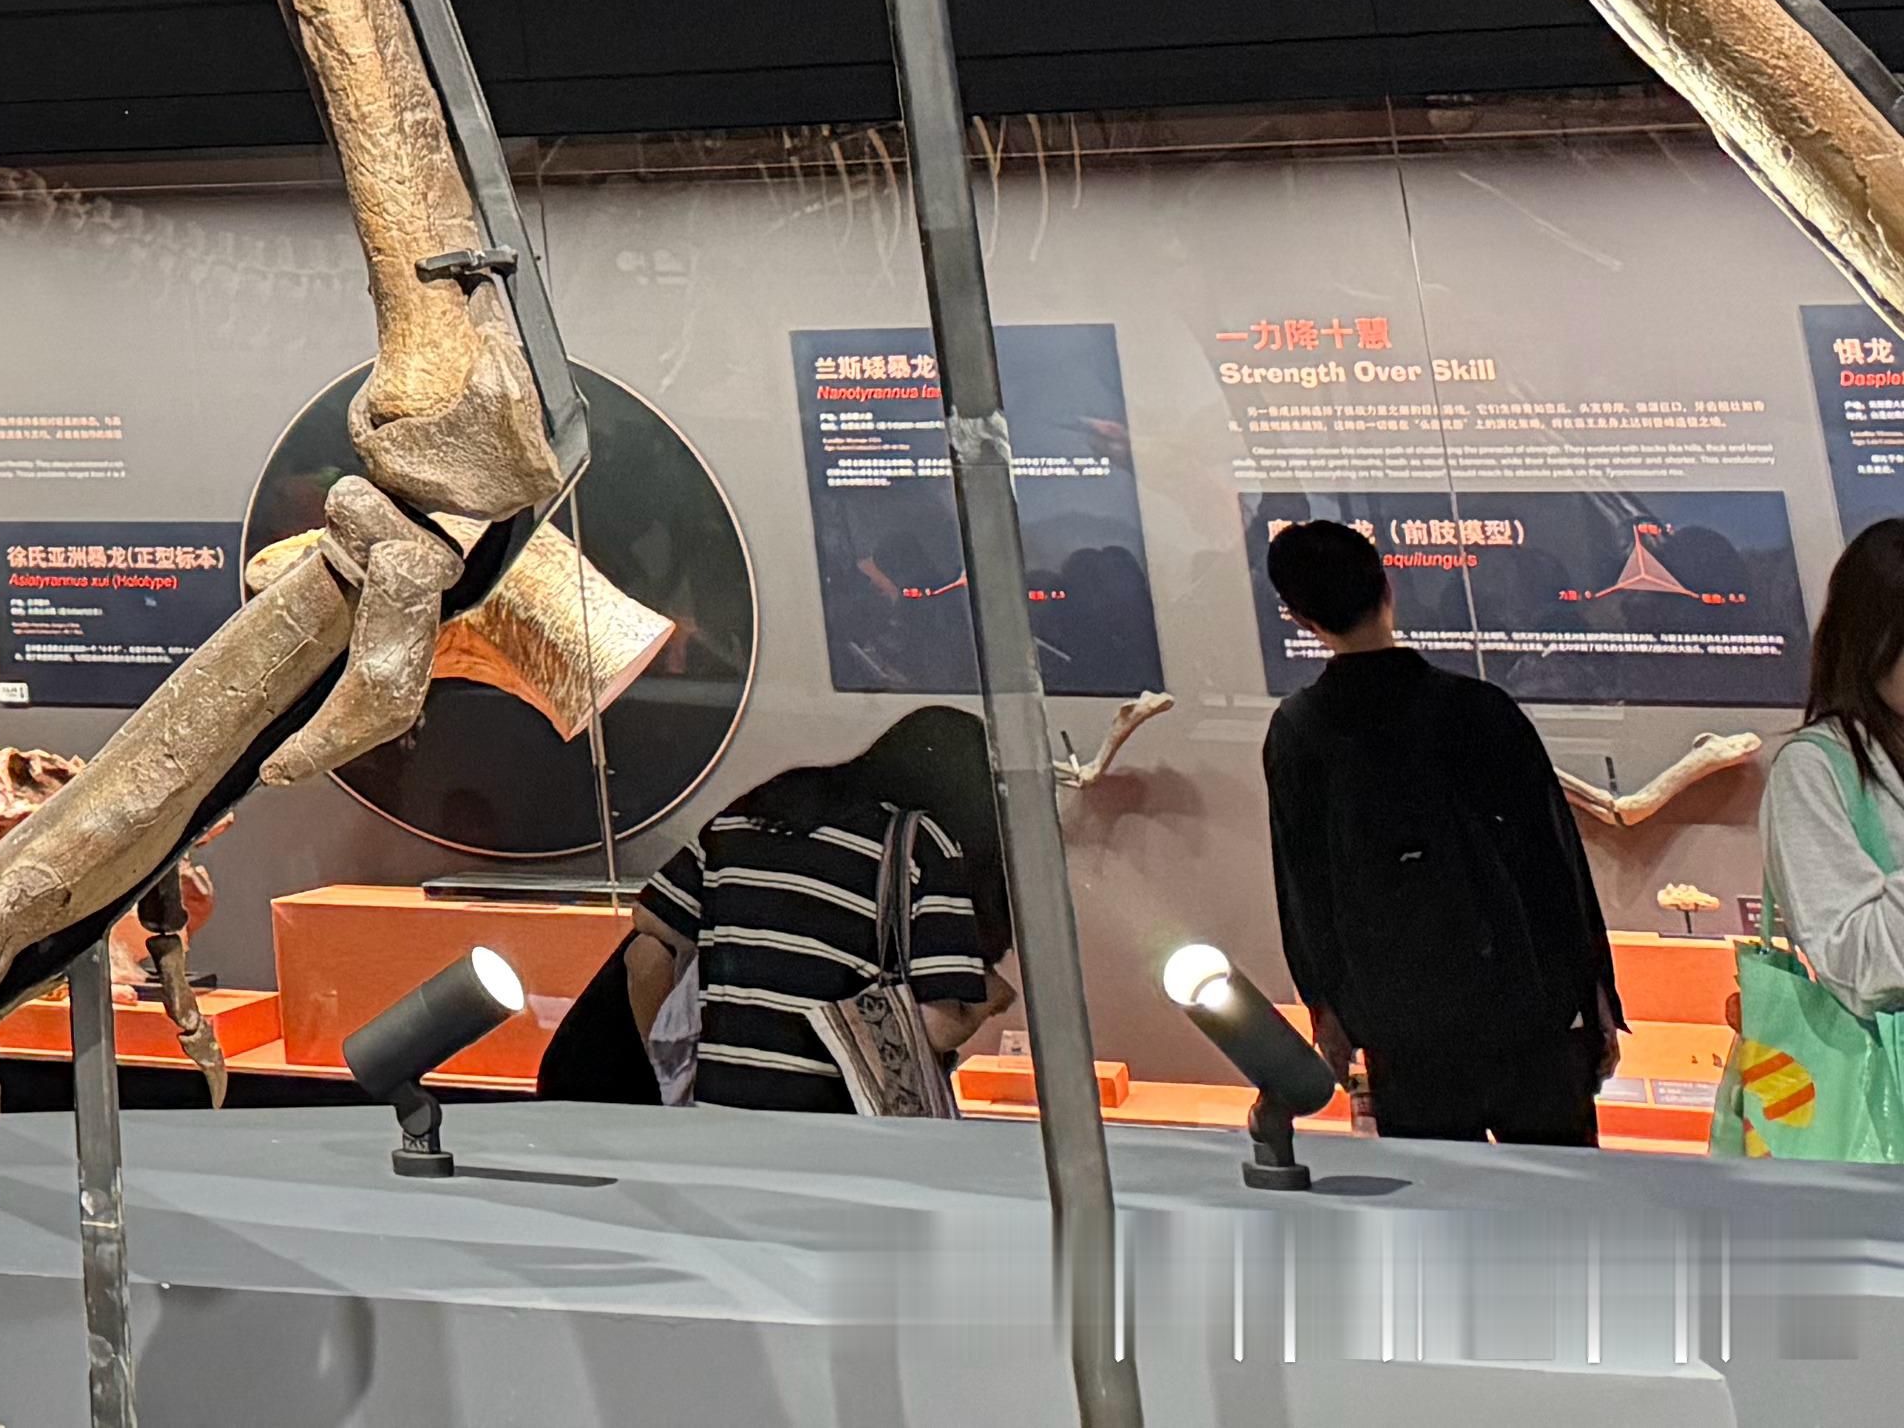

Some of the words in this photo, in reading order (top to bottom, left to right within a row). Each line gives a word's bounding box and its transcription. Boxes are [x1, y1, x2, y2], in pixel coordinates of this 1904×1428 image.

[1833, 337, 1895, 365] 惧龙
[1219, 360, 1346, 389] Strength
[1354, 360, 1422, 383] Over
[1432, 358, 1497, 382] Skill
[816, 385, 918, 402] Nanotyrannus
[113, 575, 178, 590] (Holotype)
